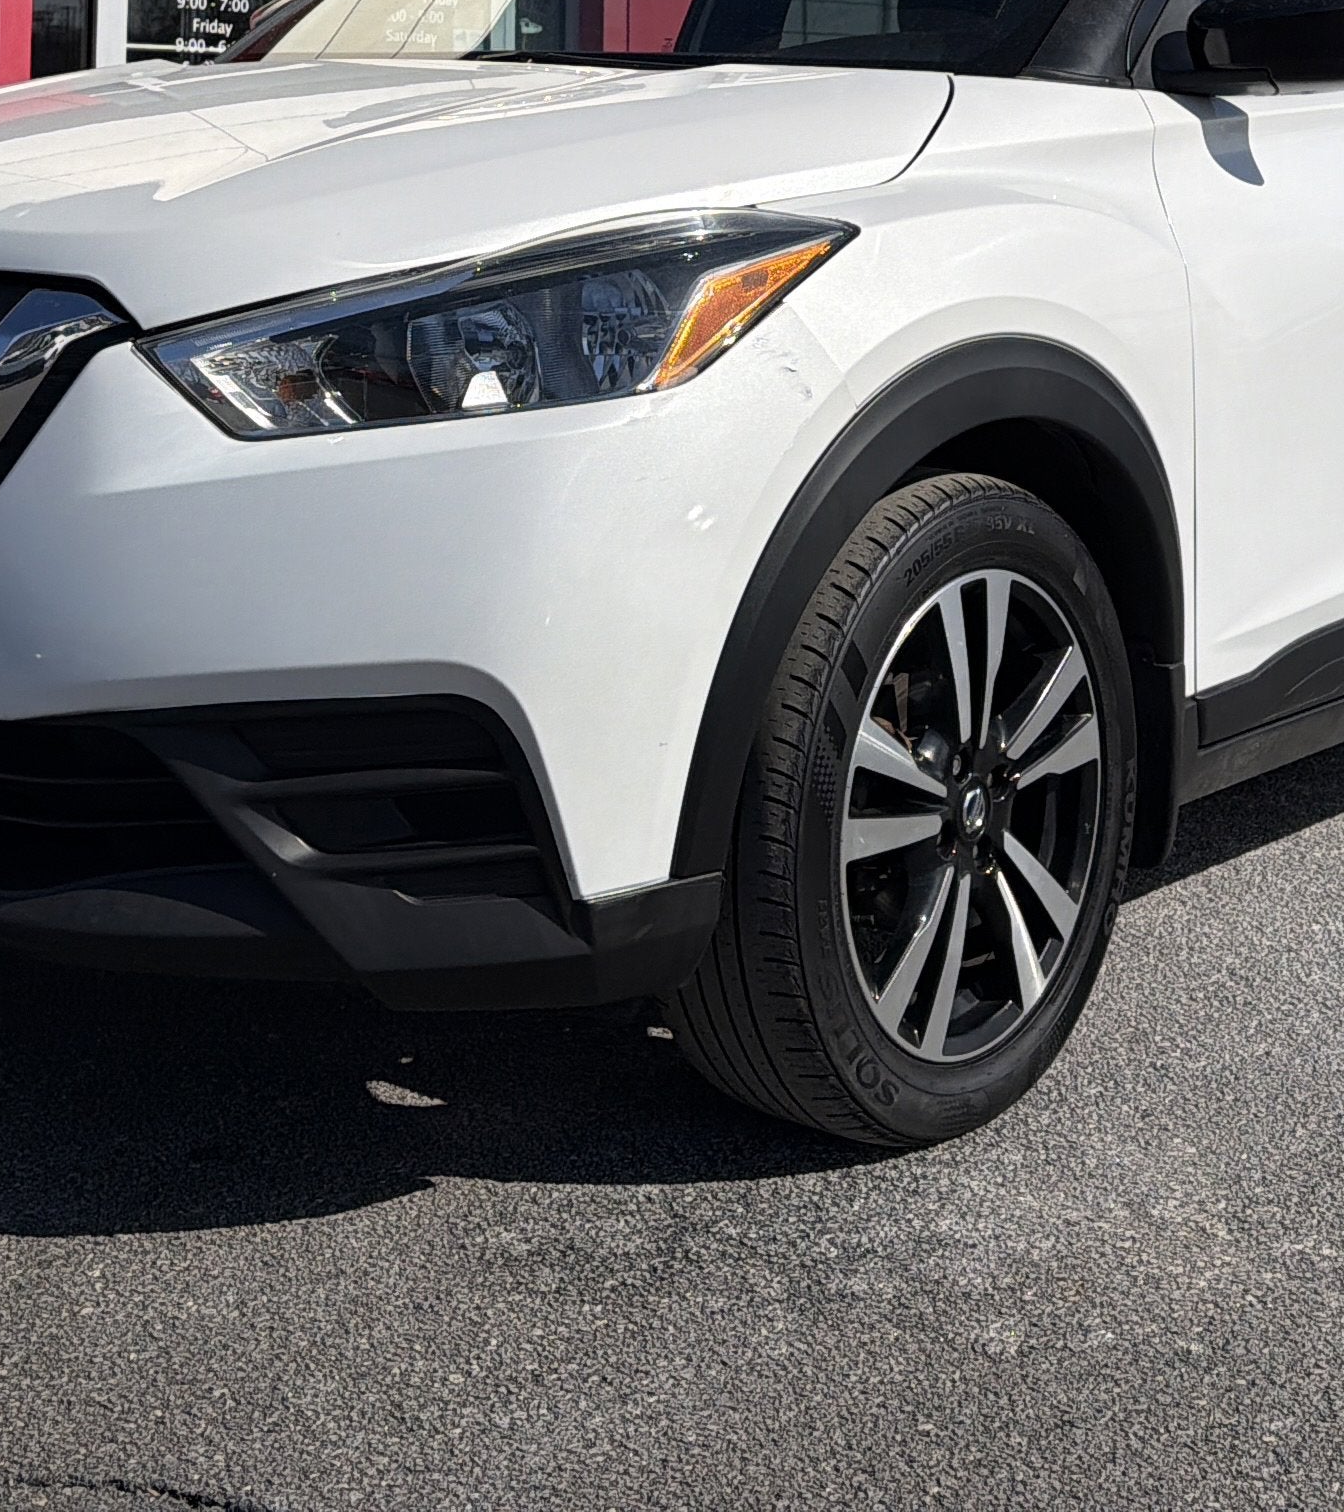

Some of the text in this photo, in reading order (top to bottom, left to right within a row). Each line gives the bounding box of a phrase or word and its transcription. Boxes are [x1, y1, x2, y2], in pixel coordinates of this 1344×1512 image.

[192, 18, 233, 37] Friday
[175, 37, 207, 53] 9:00
[902, 531, 953, 587] 205/55
